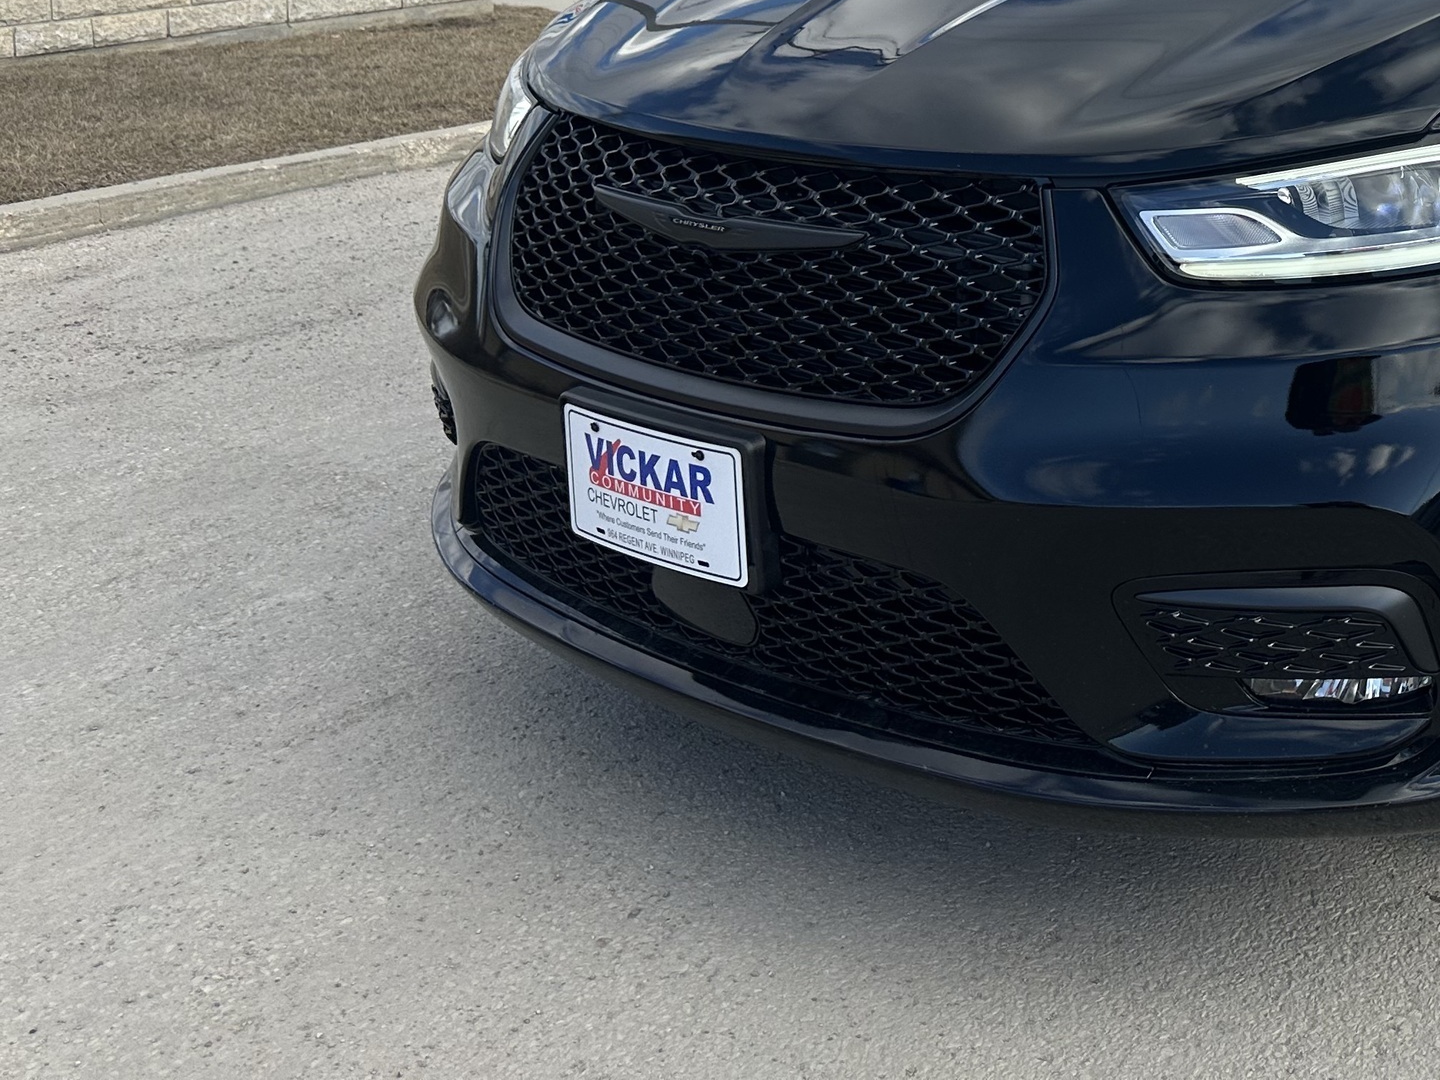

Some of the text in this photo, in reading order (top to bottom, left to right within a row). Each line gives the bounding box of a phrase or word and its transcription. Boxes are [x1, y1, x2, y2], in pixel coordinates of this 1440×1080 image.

[672, 218, 726, 232] CHRYSLER
[584, 432, 715, 505] VICKAR
[587, 487, 658, 524] CHEVROLET
[590, 471, 700, 515] COMMUNITY
[616, 518, 645, 535] Customers
[646, 527, 662, 540] Send
[663, 532, 678, 544] Their
[619, 531, 643, 549] REGENT
[660, 546, 695, 564] WINNIPEG
